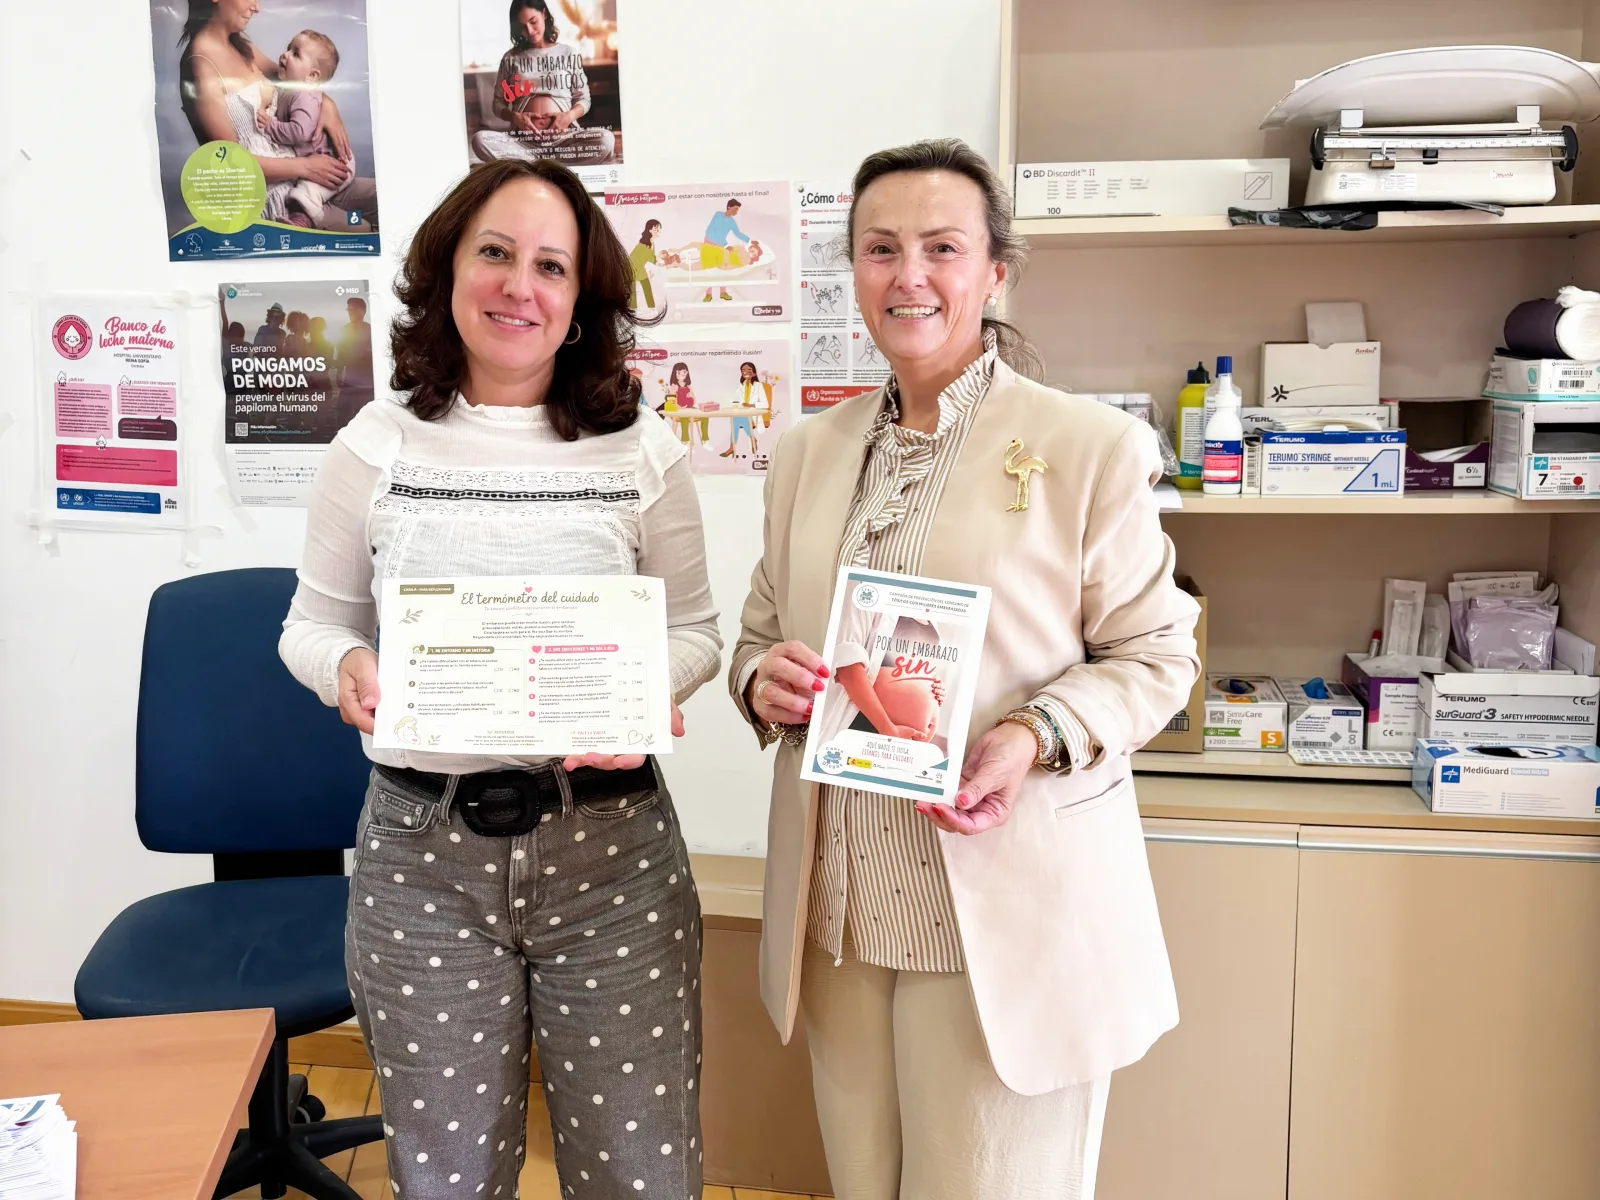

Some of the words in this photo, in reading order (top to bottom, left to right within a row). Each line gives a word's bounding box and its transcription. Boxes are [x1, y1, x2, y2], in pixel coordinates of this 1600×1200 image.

[500, 58, 518, 75] POR
[520, 57, 533, 73] UN
[536, 54, 584, 72] EMBARAZO
[540, 71, 584, 91] TÓXICOS
[1089, 168, 1095, 176] II
[800, 192, 834, 206] ¿Cómo
[837, 193, 854, 203] des
[104, 316, 148, 335] Banco
[152, 320, 166, 334] de
[100, 332, 125, 348] leche
[128, 332, 175, 350] materna
[230, 345, 248, 353] Este
[232, 357, 326, 373] PONGAMOS
[233, 374, 255, 389] DE
[258, 374, 308, 388] MODA
[236, 393, 274, 403] prevenir
[276, 392, 284, 402] el
[286, 392, 309, 402] virus
[311, 392, 326, 401] del
[235, 403, 277, 414] papiloma
[280, 403, 318, 412] humano
[1372, 472, 1378, 487] 1
[1538, 474, 1548, 486] 7
[461, 592, 473, 604] El
[476, 590, 537, 604] termómetro
[541, 591, 558, 603] del
[561, 591, 599, 603] cuidado
[876, 635, 892, 651] POR
[896, 638, 910, 654] UN
[912, 641, 958, 663] EMBARAZO
[891, 652, 936, 678] sin
[1484, 708, 1497, 720] 3
[1348, 719, 1358, 733] L
[1267, 732, 1276, 744] S
[1348, 734, 1356, 744] 8
[1464, 766, 1509, 774] MediGuard
